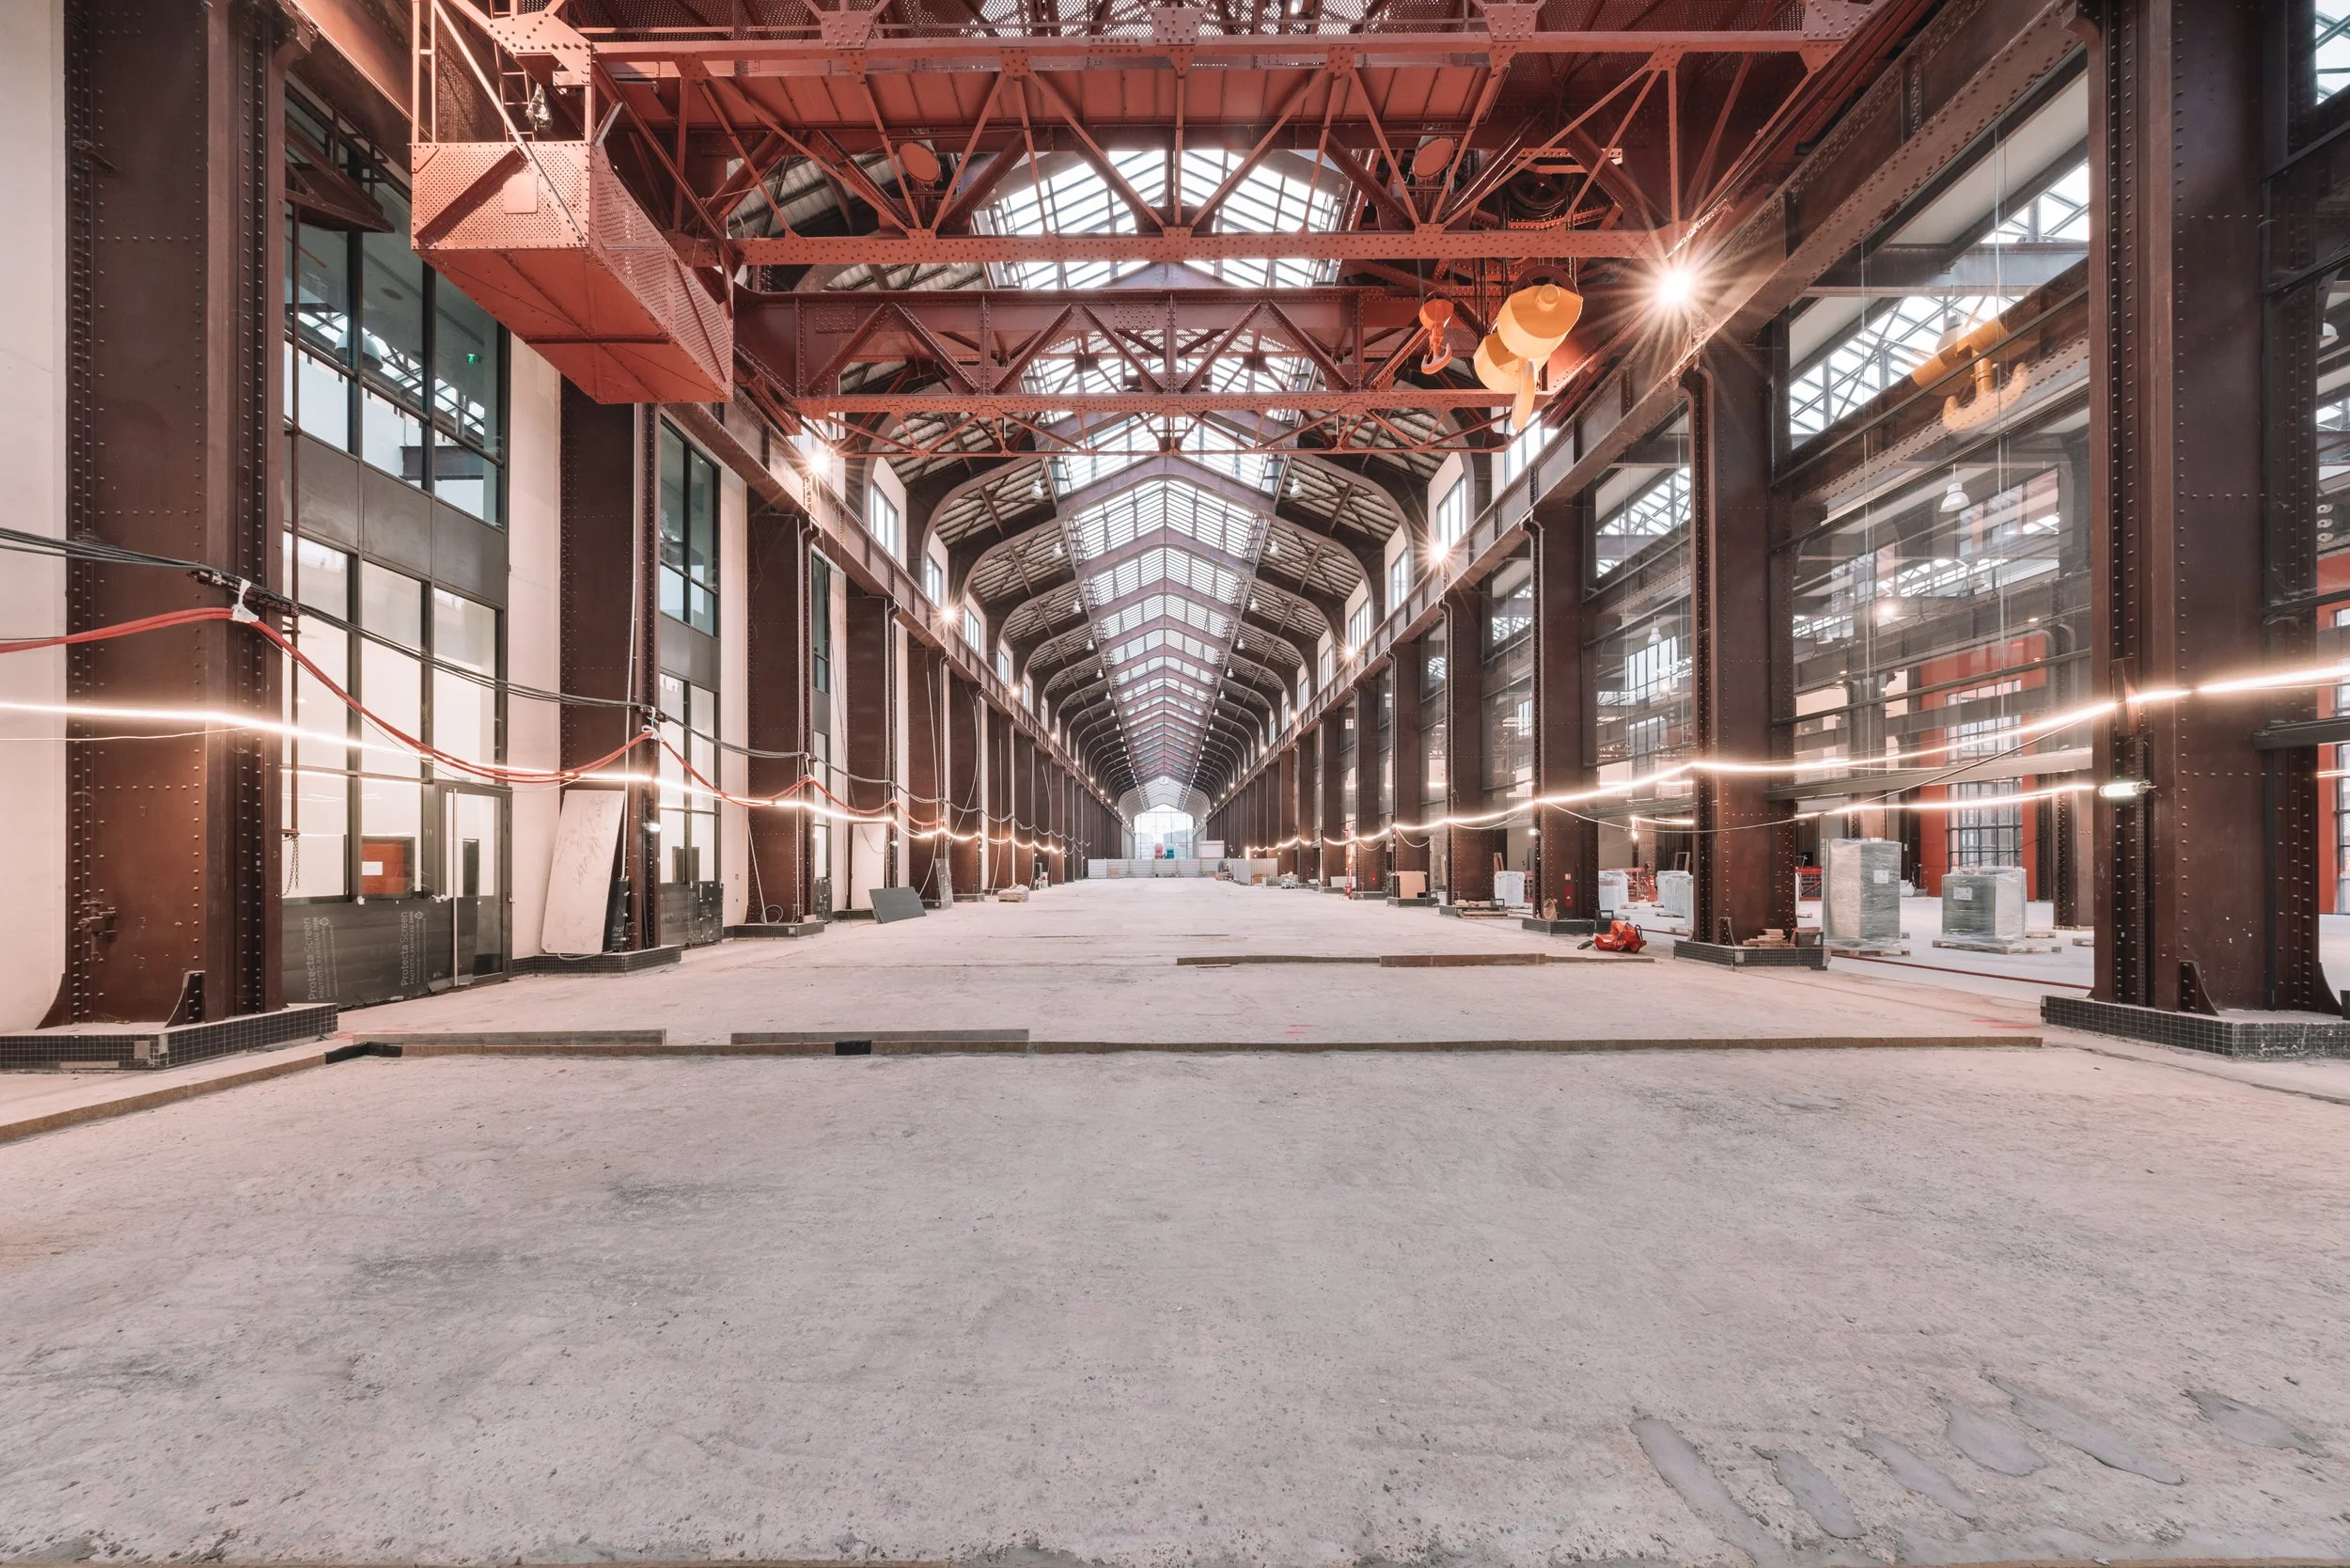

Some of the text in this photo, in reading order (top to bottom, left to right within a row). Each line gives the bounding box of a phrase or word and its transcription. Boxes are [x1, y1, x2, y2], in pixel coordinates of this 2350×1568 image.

[304, 917, 318, 1000] Protecta Screen
[400, 911, 409, 986] Protecta Screen
